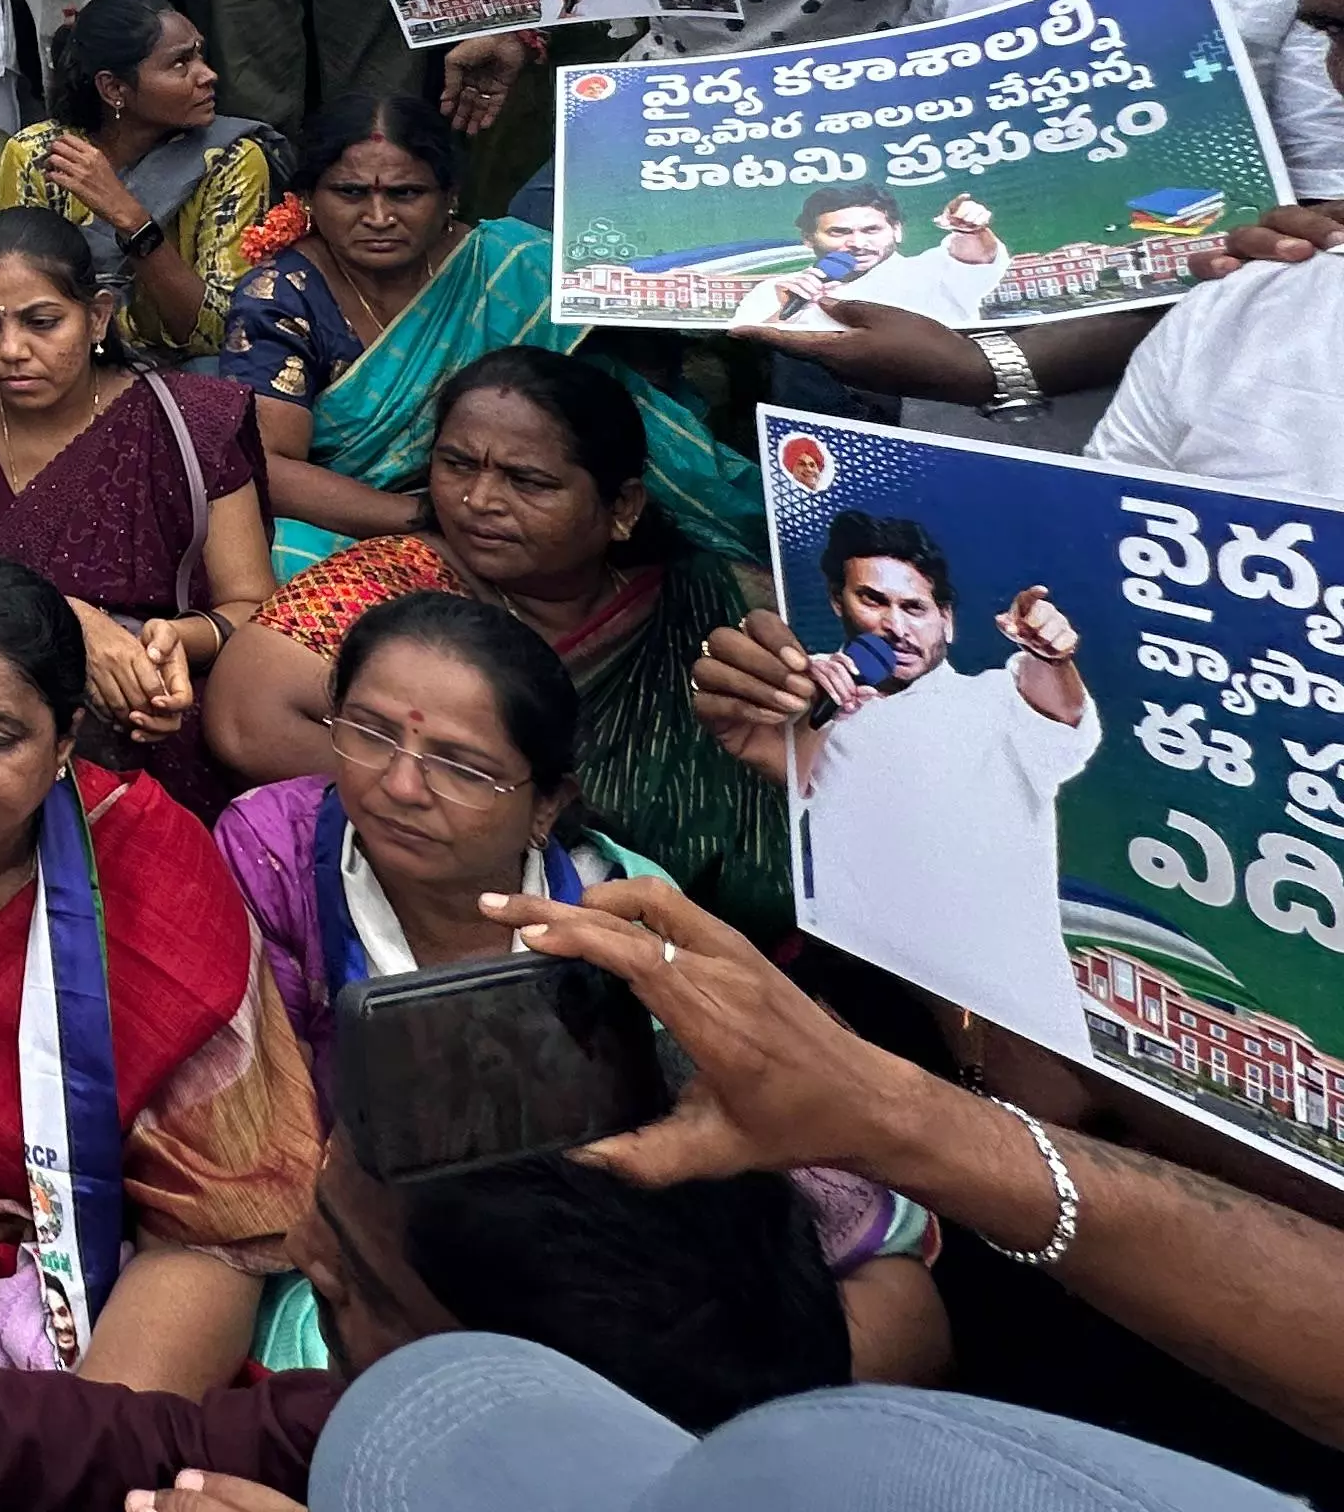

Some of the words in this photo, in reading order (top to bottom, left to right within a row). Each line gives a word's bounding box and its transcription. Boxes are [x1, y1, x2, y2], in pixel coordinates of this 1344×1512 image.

[641, 67, 765, 120] వైద్య
[643, 115, 804, 158] వ్యాపార
[814, 92, 975, 136] శాలలు
[987, 50, 1157, 117] చేస్తున్న
[640, 144, 867, 192] కూటమి
[886, 96, 1168, 189] ప్రభుత్వం
[1134, 701, 1257, 787] ఈ
